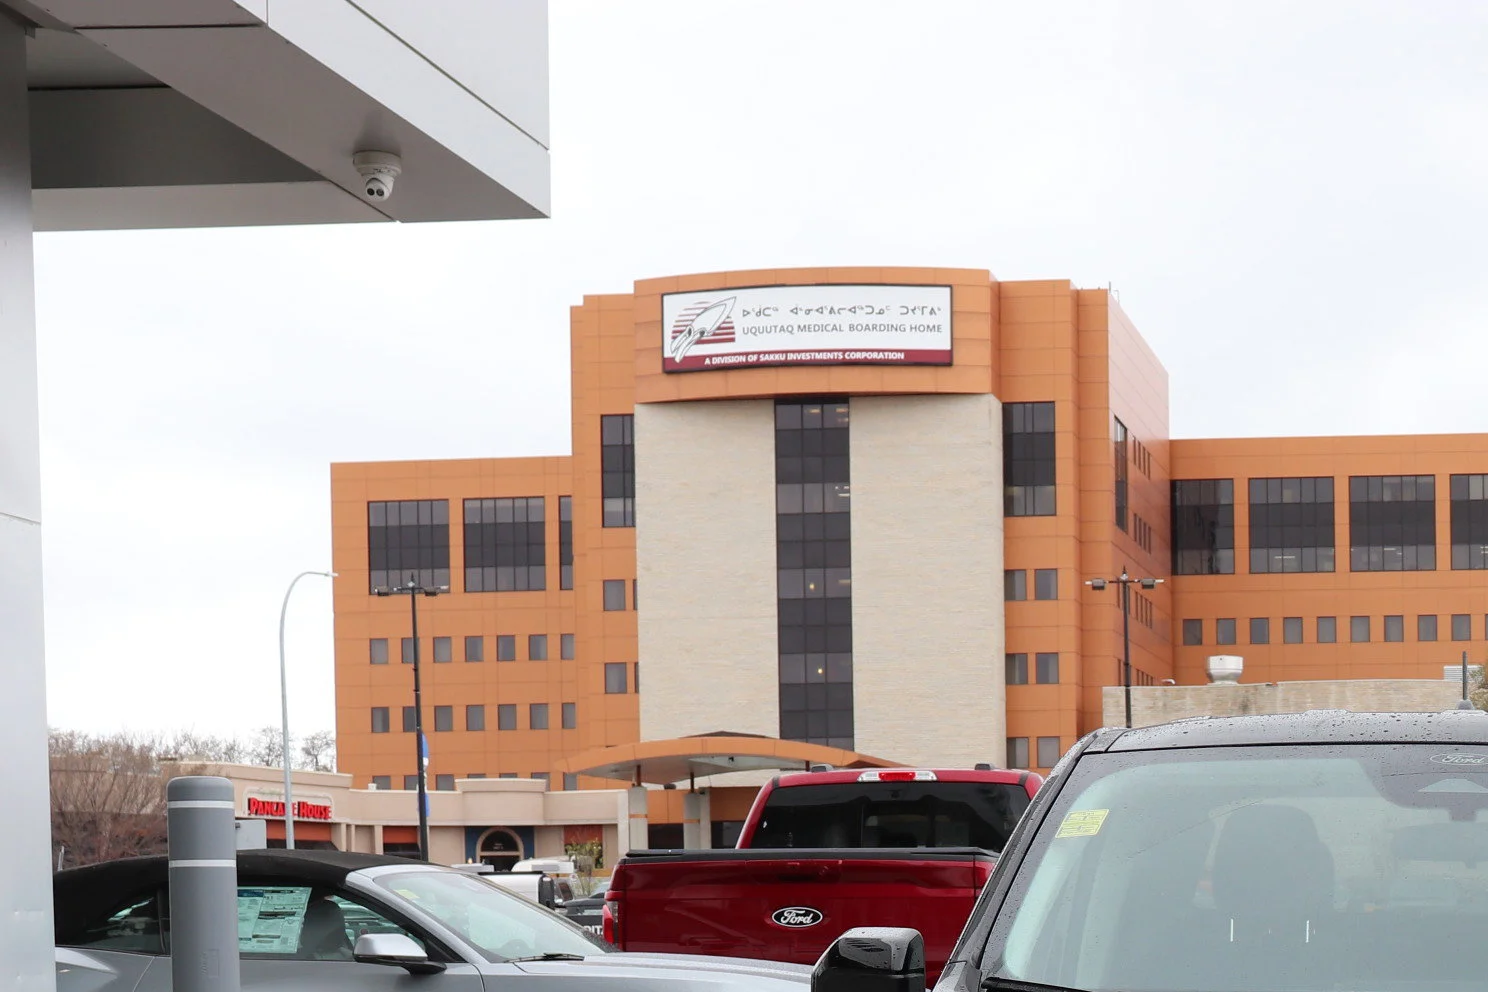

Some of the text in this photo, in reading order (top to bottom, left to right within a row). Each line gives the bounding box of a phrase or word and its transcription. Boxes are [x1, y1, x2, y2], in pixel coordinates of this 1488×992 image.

[742, 323, 943, 336] UQUUTAQ MEDICAL BOARDING HOME
[704, 351, 905, 365] A DIVISION OF SAKKU INVESTMENTS CORPORATION
[247, 797, 332, 820] PANCAE HOUSE
[780, 909, 814, 924] Ford
